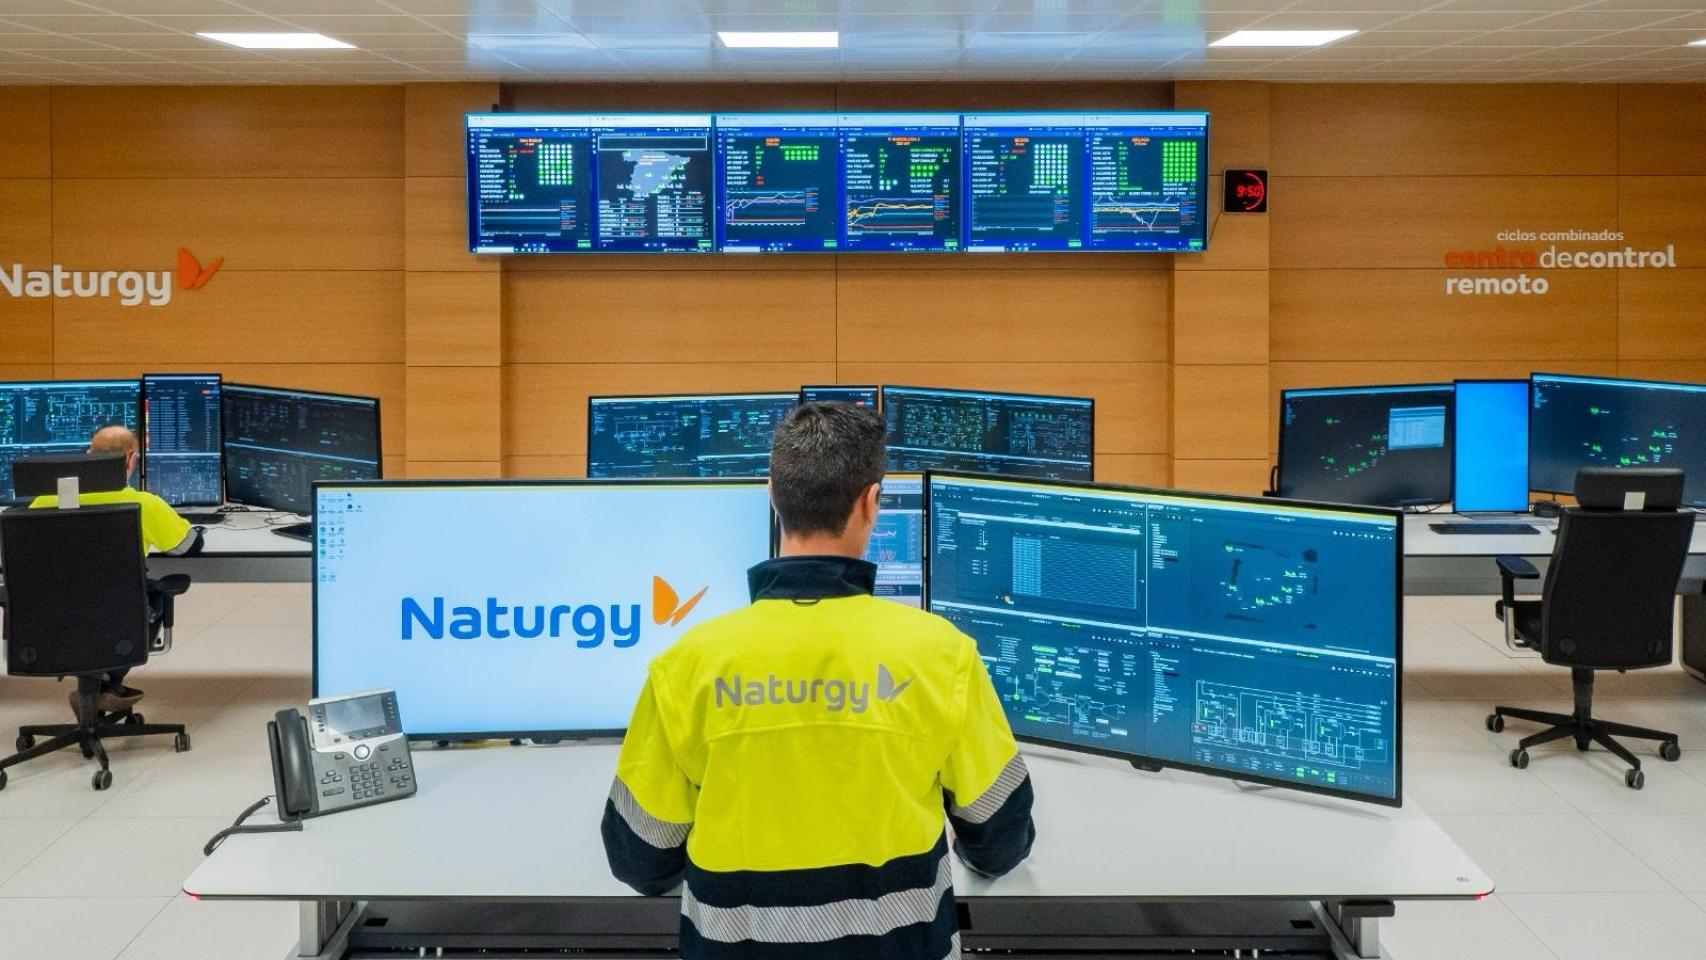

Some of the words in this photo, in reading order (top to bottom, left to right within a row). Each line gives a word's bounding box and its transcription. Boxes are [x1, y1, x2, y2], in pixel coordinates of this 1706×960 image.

[1497, 229, 1536, 241] ciclos
[1540, 229, 1624, 241] combinados
[0, 263, 172, 306] Naturgy
[1446, 273, 1549, 295] remoto
[401, 597, 641, 648] Naturgy
[714, 673, 870, 714] Naturgy
